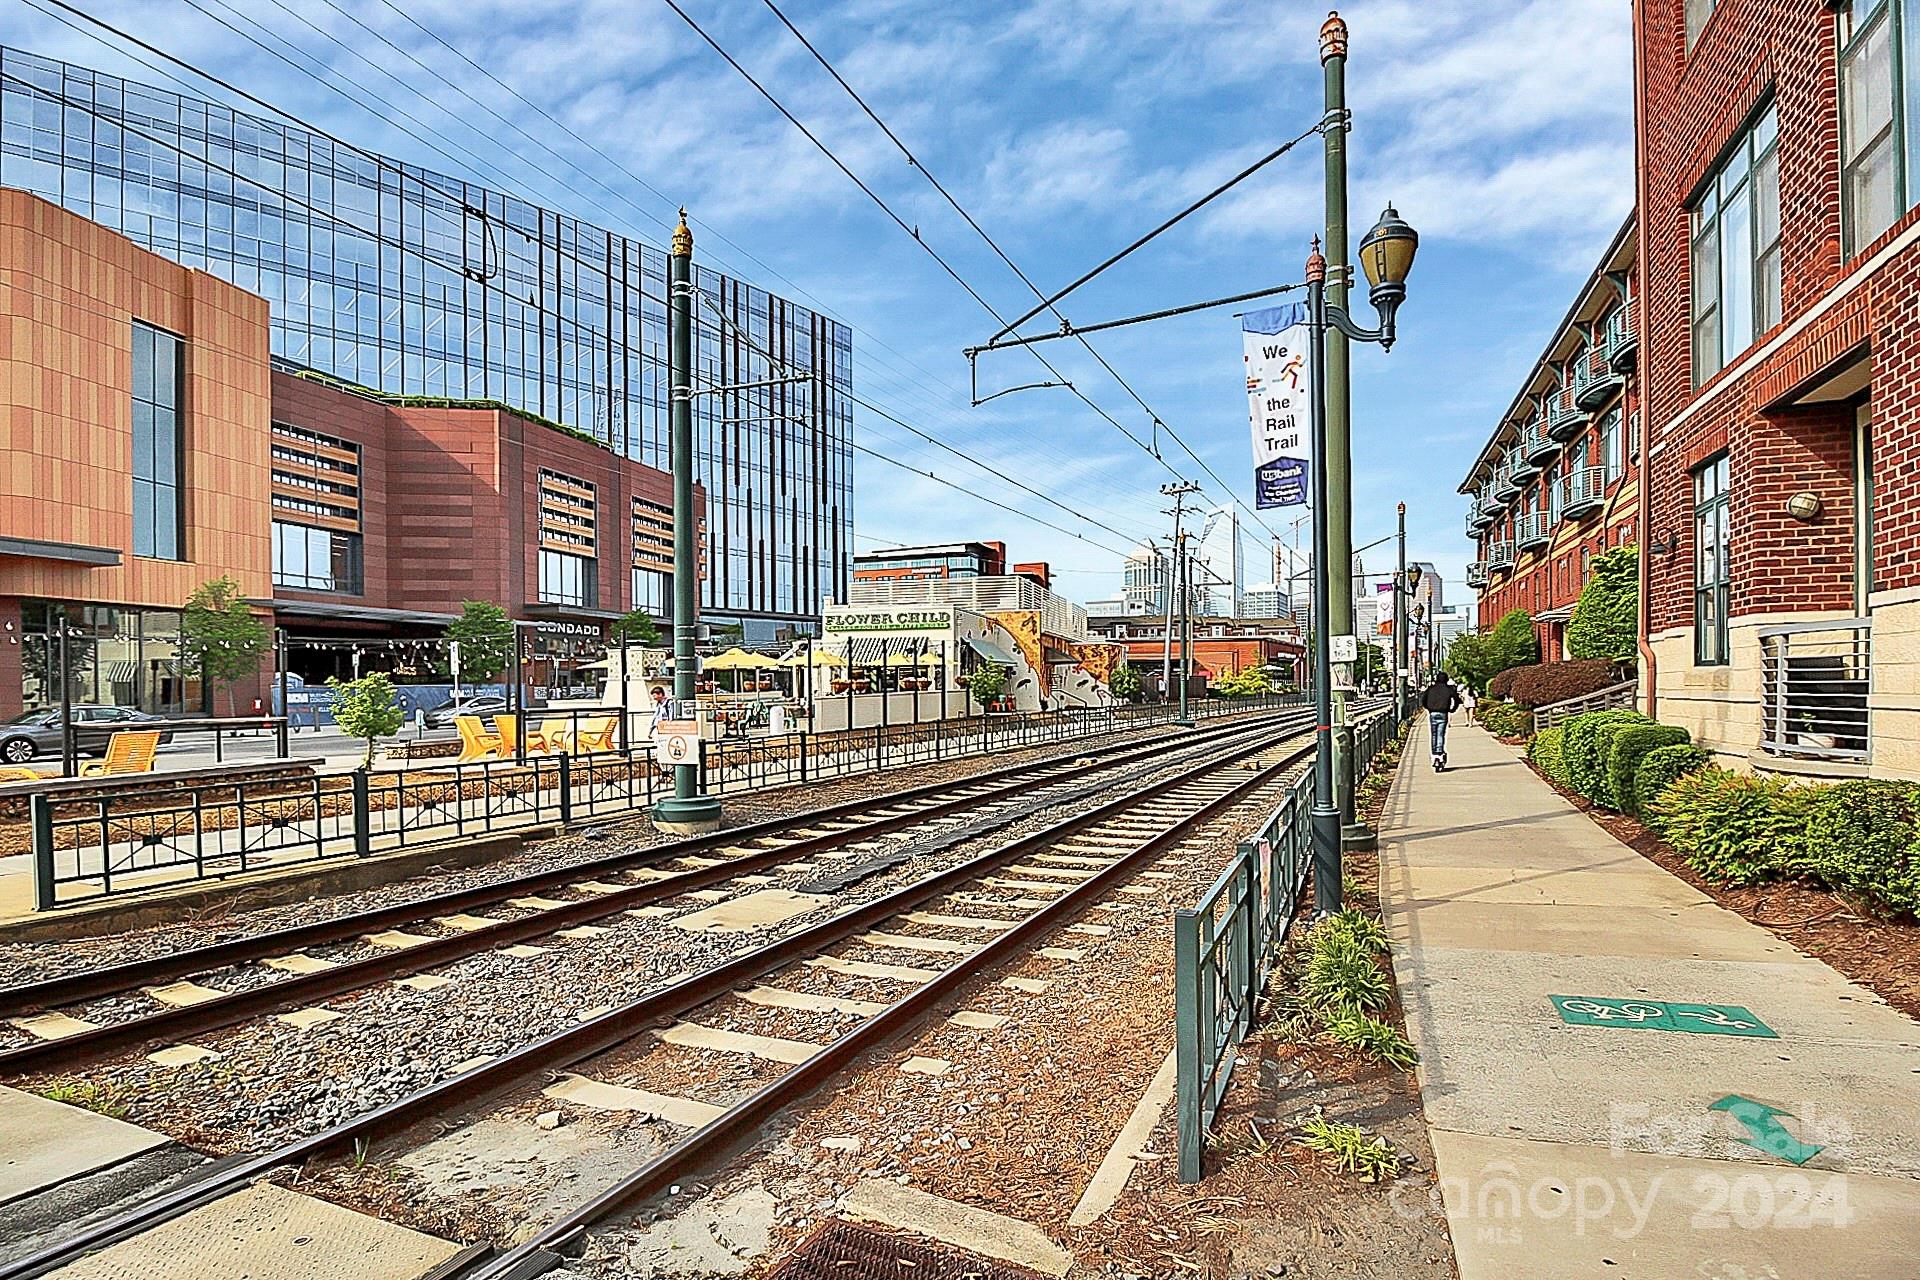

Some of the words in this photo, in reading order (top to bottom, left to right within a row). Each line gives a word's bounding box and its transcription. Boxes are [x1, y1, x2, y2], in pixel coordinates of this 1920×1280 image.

[1263, 345, 1288, 360] We
[1267, 398, 1290, 411] the
[1266, 414, 1296, 431] Rail
[1264, 434, 1298, 451] Trail
[825, 614, 894, 626] FLOWER
[897, 612, 951, 624] CHILD
[537, 621, 600, 636] CONDADO
